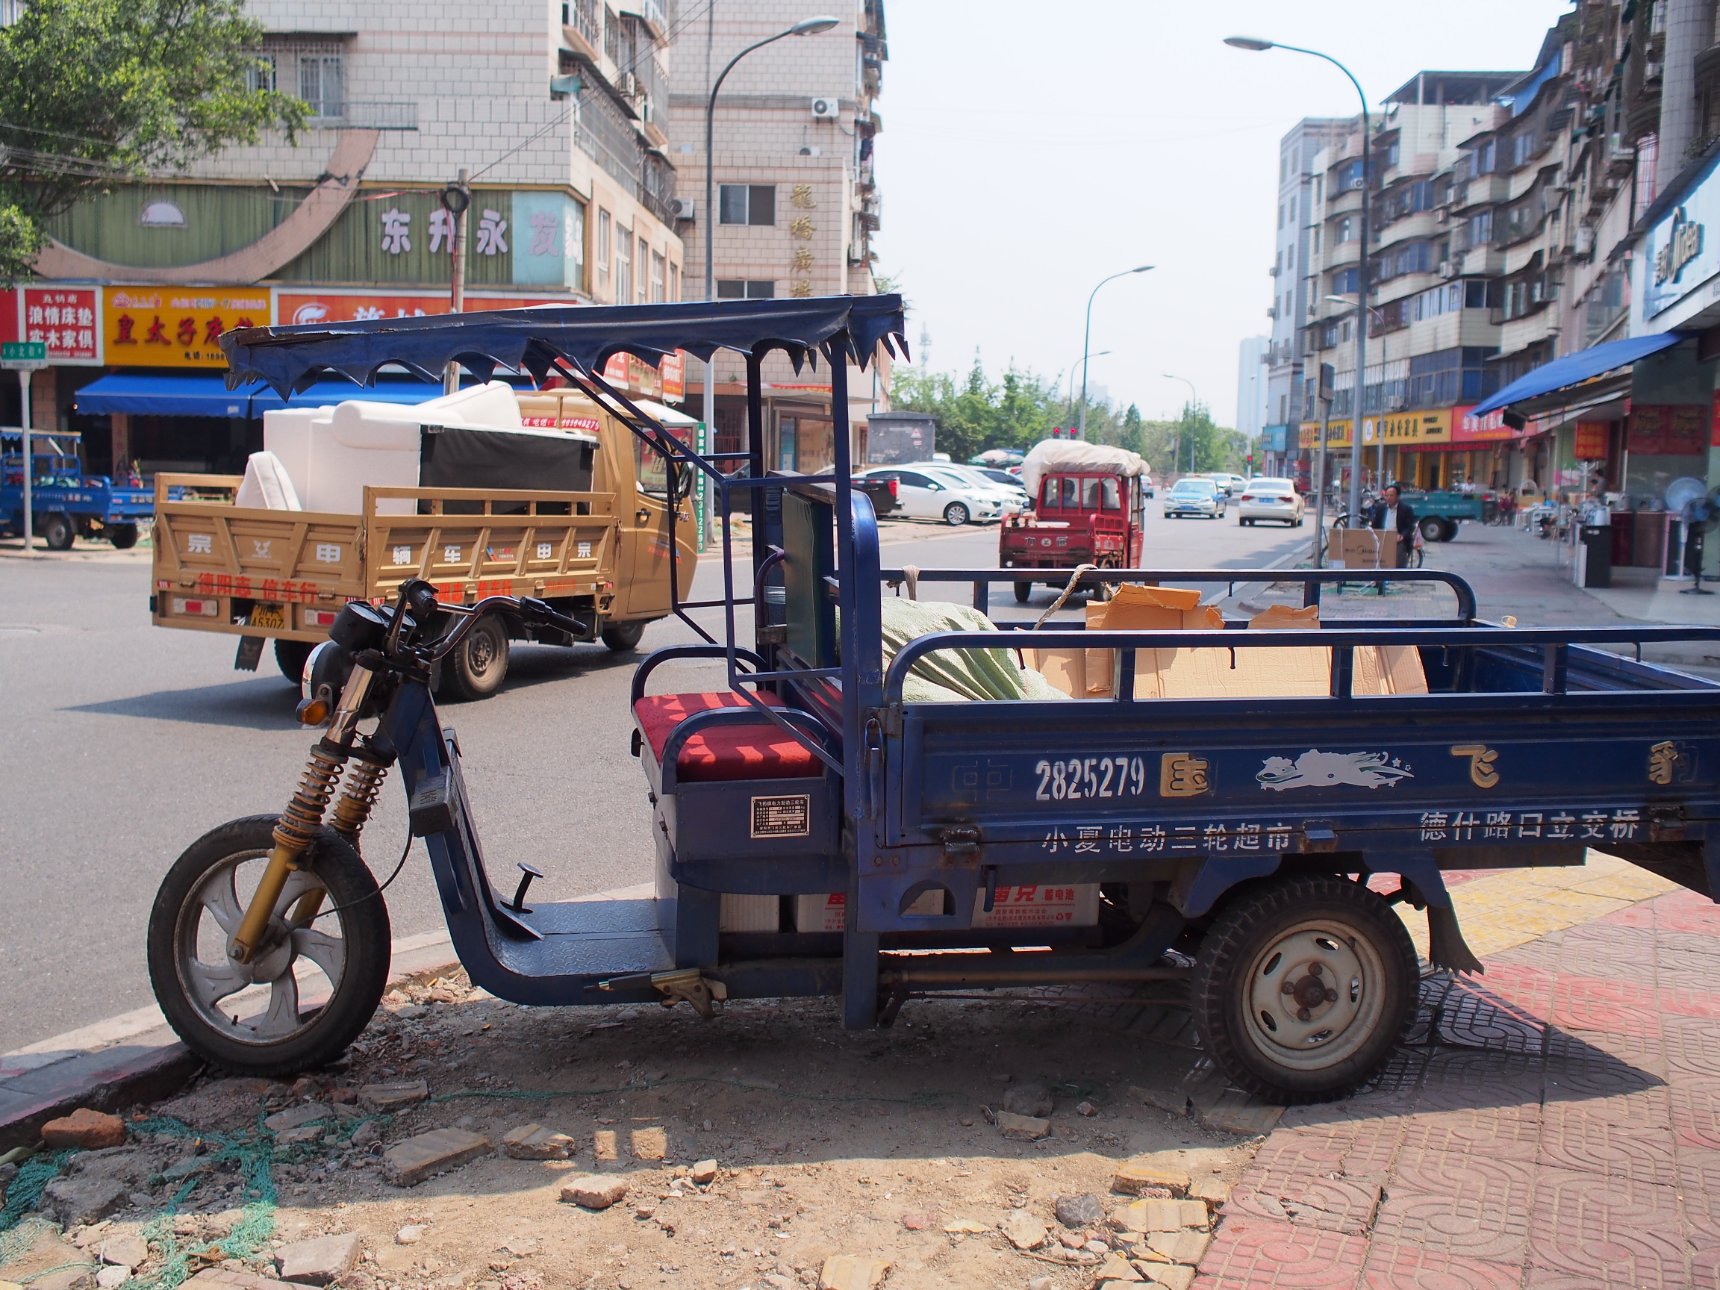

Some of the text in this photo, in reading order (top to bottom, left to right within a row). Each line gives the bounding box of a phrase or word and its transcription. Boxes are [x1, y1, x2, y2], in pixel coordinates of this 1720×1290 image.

[29, 304, 93, 327] 浪情床垫
[29, 328, 93, 349] 实木家俱
[188, 534, 341, 563] 宗 申
[1035, 756, 1145, 801] 2825279
[1451, 744, 1499, 789] 飞
[1041, 822, 1293, 854] 小夏电动三轮超市
[1419, 809, 1641, 841] 德什路口立交桥
